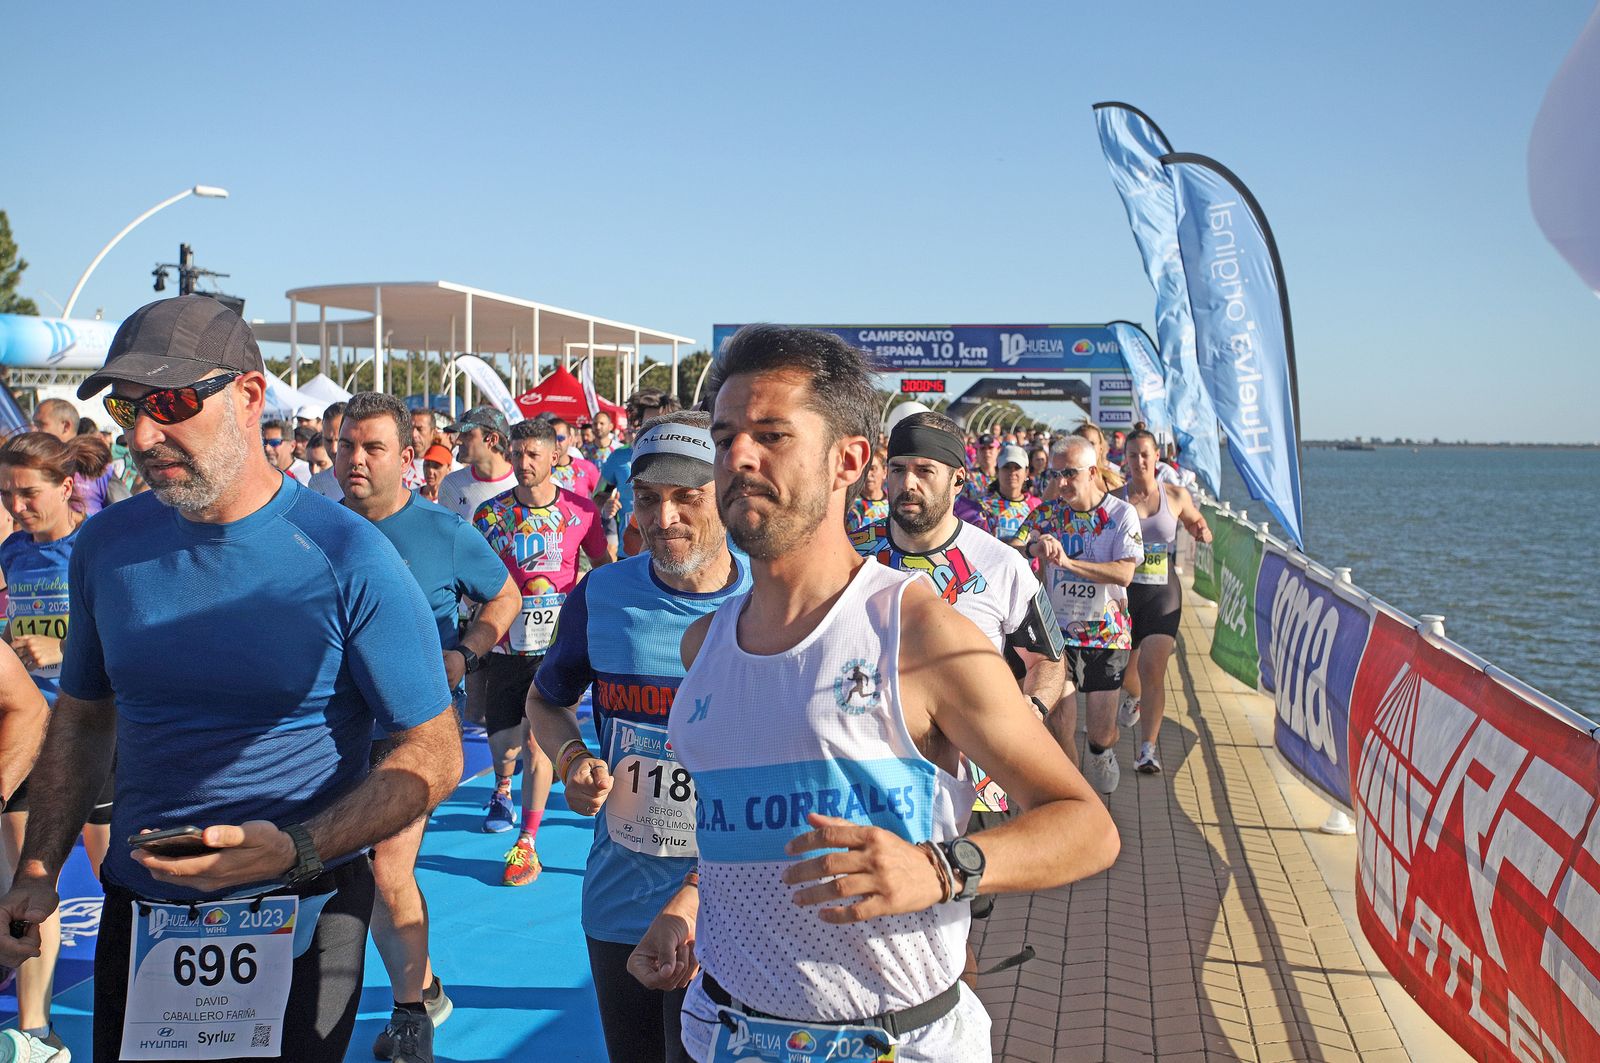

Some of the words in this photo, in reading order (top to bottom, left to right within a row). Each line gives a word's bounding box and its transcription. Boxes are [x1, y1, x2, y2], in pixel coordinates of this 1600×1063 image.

[858, 330, 954, 342] CAMPEONATO
[876, 344, 924, 357] ESPAÑA
[931, 343, 954, 359] 10
[958, 342, 988, 358] km
[1025, 339, 1064, 353] HUELVA
[650, 433, 711, 450] LURBEL
[18, 583, 32, 592] km
[1060, 583, 1096, 599] 1429
[48, 601, 70, 612] 2023
[521, 610, 554, 626] 792
[16, 618, 68, 640] 1170
[634, 737, 661, 751] HUELVA
[627, 760, 699, 802] 118
[648, 806, 683, 818] SERGIO
[745, 783, 915, 831] CORRALES
[636, 815, 665, 827] LARGO
[666, 819, 695, 831] LIMON
[615, 829, 644, 844] HYUNDAI
[652, 833, 688, 847] Syrluz
[167, 911, 200, 928] HUELVA
[239, 908, 284, 929] 2023
[173, 943, 258, 987] 696
[1408, 895, 1568, 1063] ATLE
[195, 996, 229, 1007] DAVID
[163, 1010, 224, 1022] CABALLERO
[226, 1008, 256, 1020] FARIÑA
[140, 1040, 188, 1049] HYUNDAI
[197, 1030, 236, 1046] Syrluz
